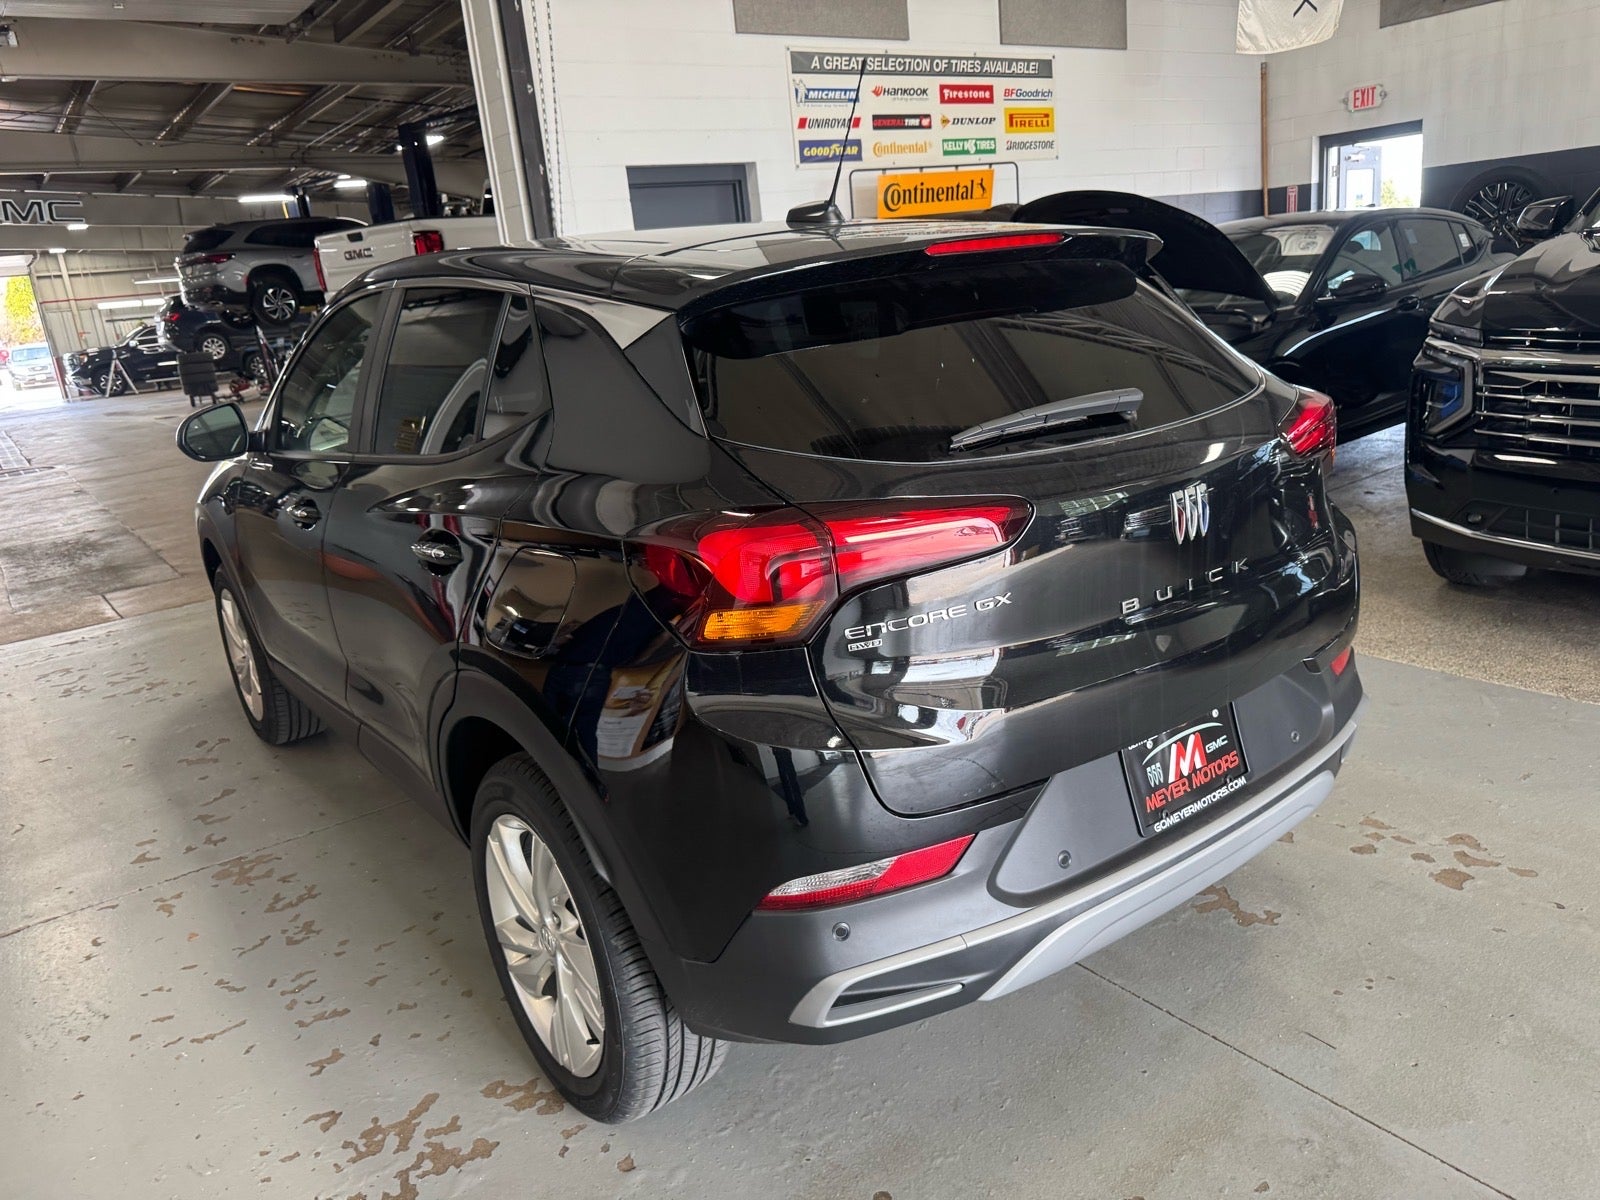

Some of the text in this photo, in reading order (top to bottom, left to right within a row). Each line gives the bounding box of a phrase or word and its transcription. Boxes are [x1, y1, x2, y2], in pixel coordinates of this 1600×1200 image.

[811, 55, 1039, 74] A GREAT SELECTION OF TIRES AVAILABLE!
[808, 89, 858, 99] MICHELIN
[1003, 88, 1053, 98] BFGoodrich
[1353, 86, 1377, 109] EXIT
[873, 117, 920, 127] GENERAL TIRE
[952, 117, 996, 126] DUNLOP
[1008, 113, 1050, 128] PIRELLI
[872, 141, 928, 158] Continental
[943, 140, 963, 151] KELLY
[976, 140, 995, 150] TIRES
[1006, 140, 1055, 151] BRIDGESTONE
[883, 179, 975, 213] Continental
[0, 199, 85, 224] MC
[343, 248, 374, 261] GMC
[1120, 557, 1249, 615] BUICK
[844, 592, 1012, 640] ENCORE GX
[848, 639, 883, 652] AWD
[1205, 735, 1229, 754] GMC
[1145, 750, 1240, 814] MEYER MOTORS
[1153, 775, 1247, 833] GOMEYERMOTORS.COM
